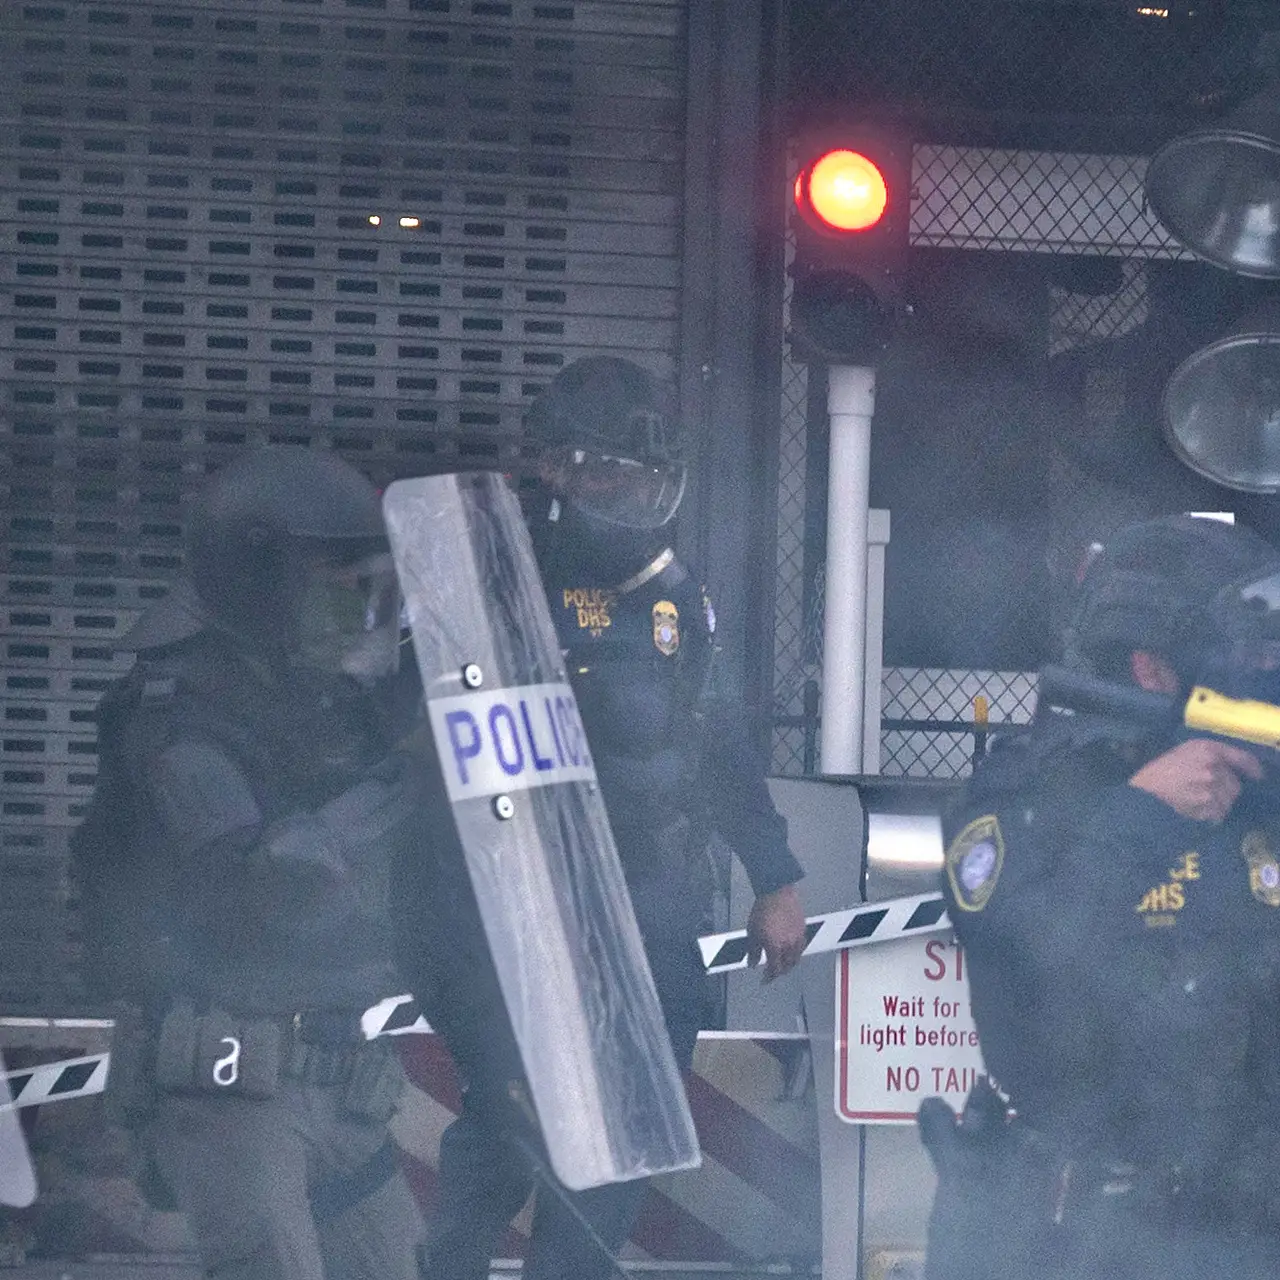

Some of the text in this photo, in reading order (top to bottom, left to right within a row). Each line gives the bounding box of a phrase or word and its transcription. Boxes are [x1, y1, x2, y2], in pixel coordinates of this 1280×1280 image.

[577, 608, 611, 628] DHS
[883, 996, 961, 1018] Wait for
[860, 1023, 980, 1052] light before
[886, 1066, 920, 1092] NO
